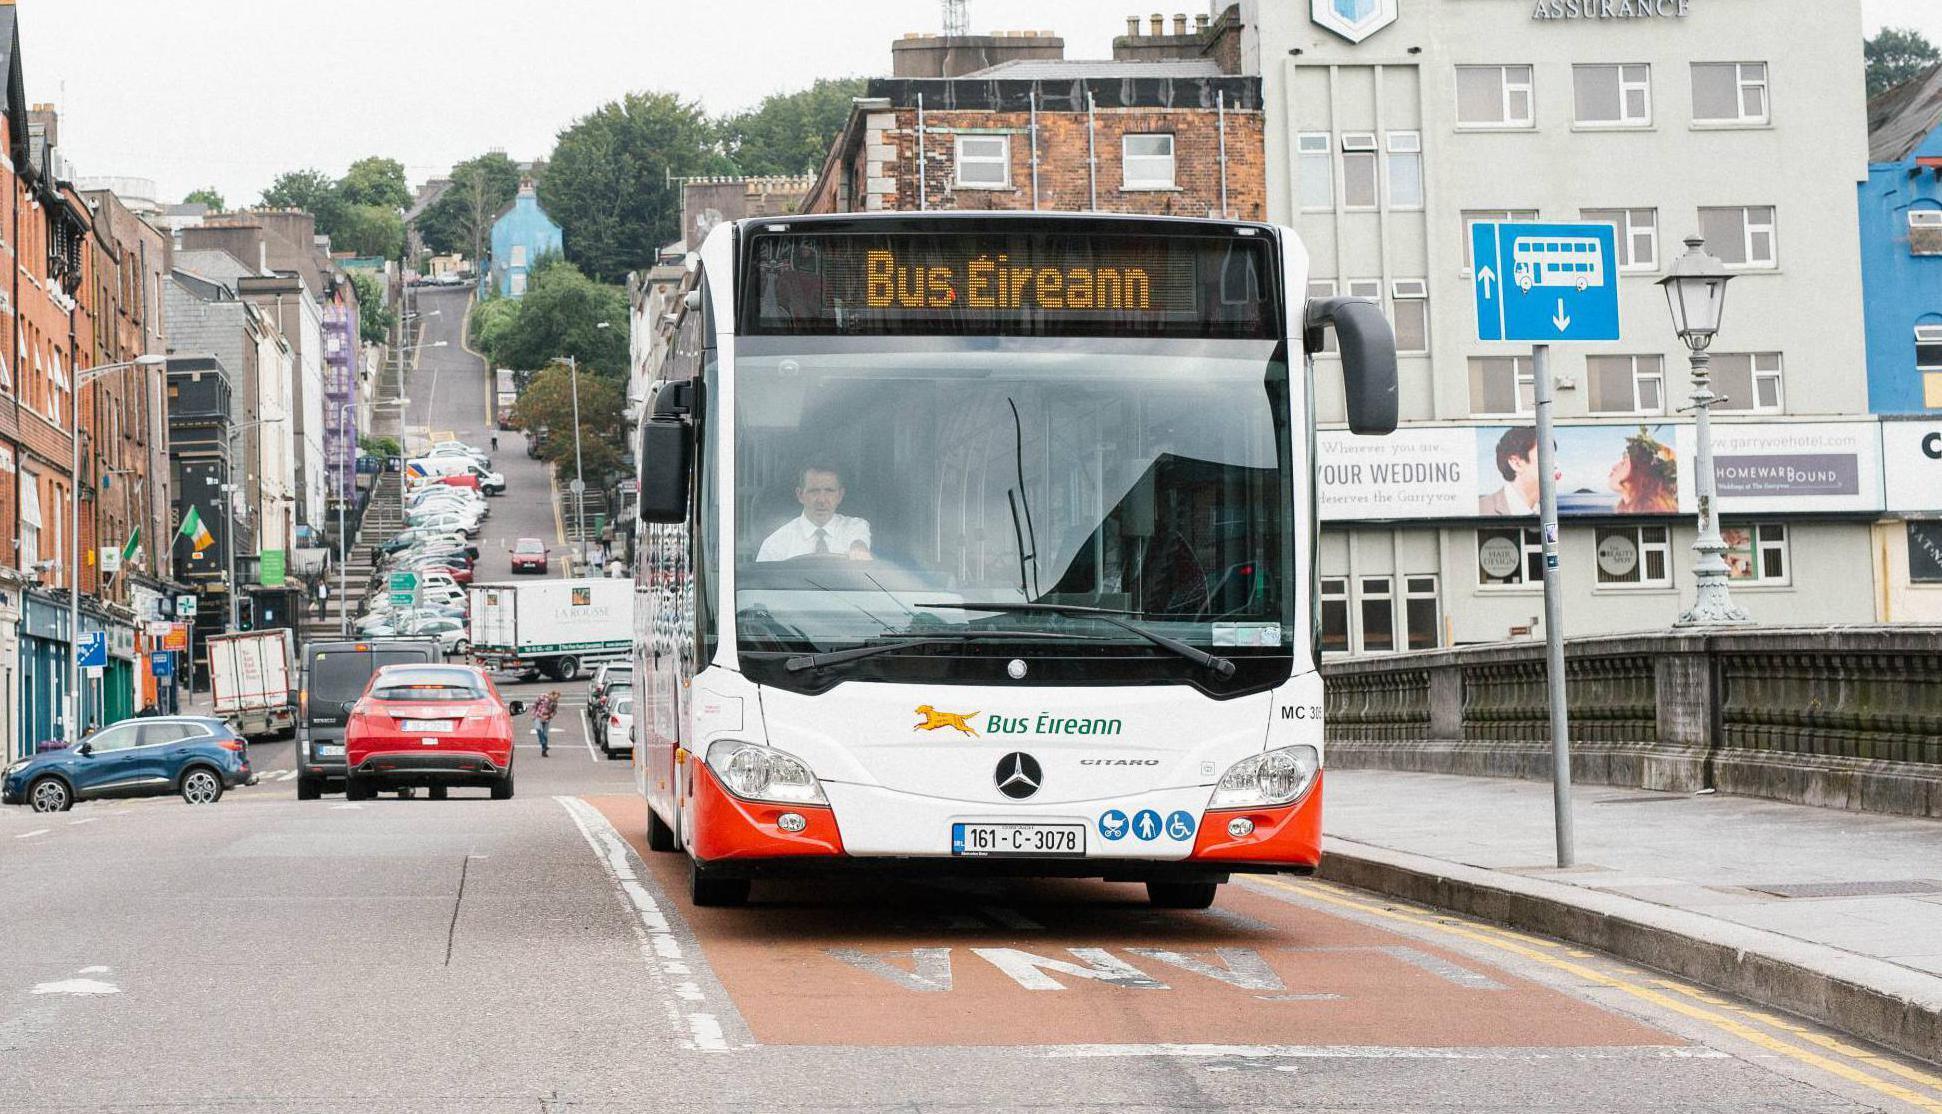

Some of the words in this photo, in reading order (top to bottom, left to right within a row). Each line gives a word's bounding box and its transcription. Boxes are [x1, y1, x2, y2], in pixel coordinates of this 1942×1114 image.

[1532, 0, 1689, 20] ASSURANCE
[866, 249, 954, 309] Bus
[967, 253, 1151, 309] Éireann
[1322, 441, 1385, 455] Wherever
[1391, 443, 1416, 456] you
[1708, 435, 1857, 450] ww.garryvoehotel.com
[1370, 462, 1461, 485] WEDDING
[1716, 466, 1795, 480] HOMEWARD
[1787, 471, 1837, 483] BOUND
[1374, 490, 1393, 503] the
[1397, 489, 1457, 505] Garryvoe
[1281, 705, 1305, 720] MC
[986, 714, 1029, 735] Bus
[1036, 711, 1122, 736] Éireann
[1080, 758, 1160, 767] CITARO
